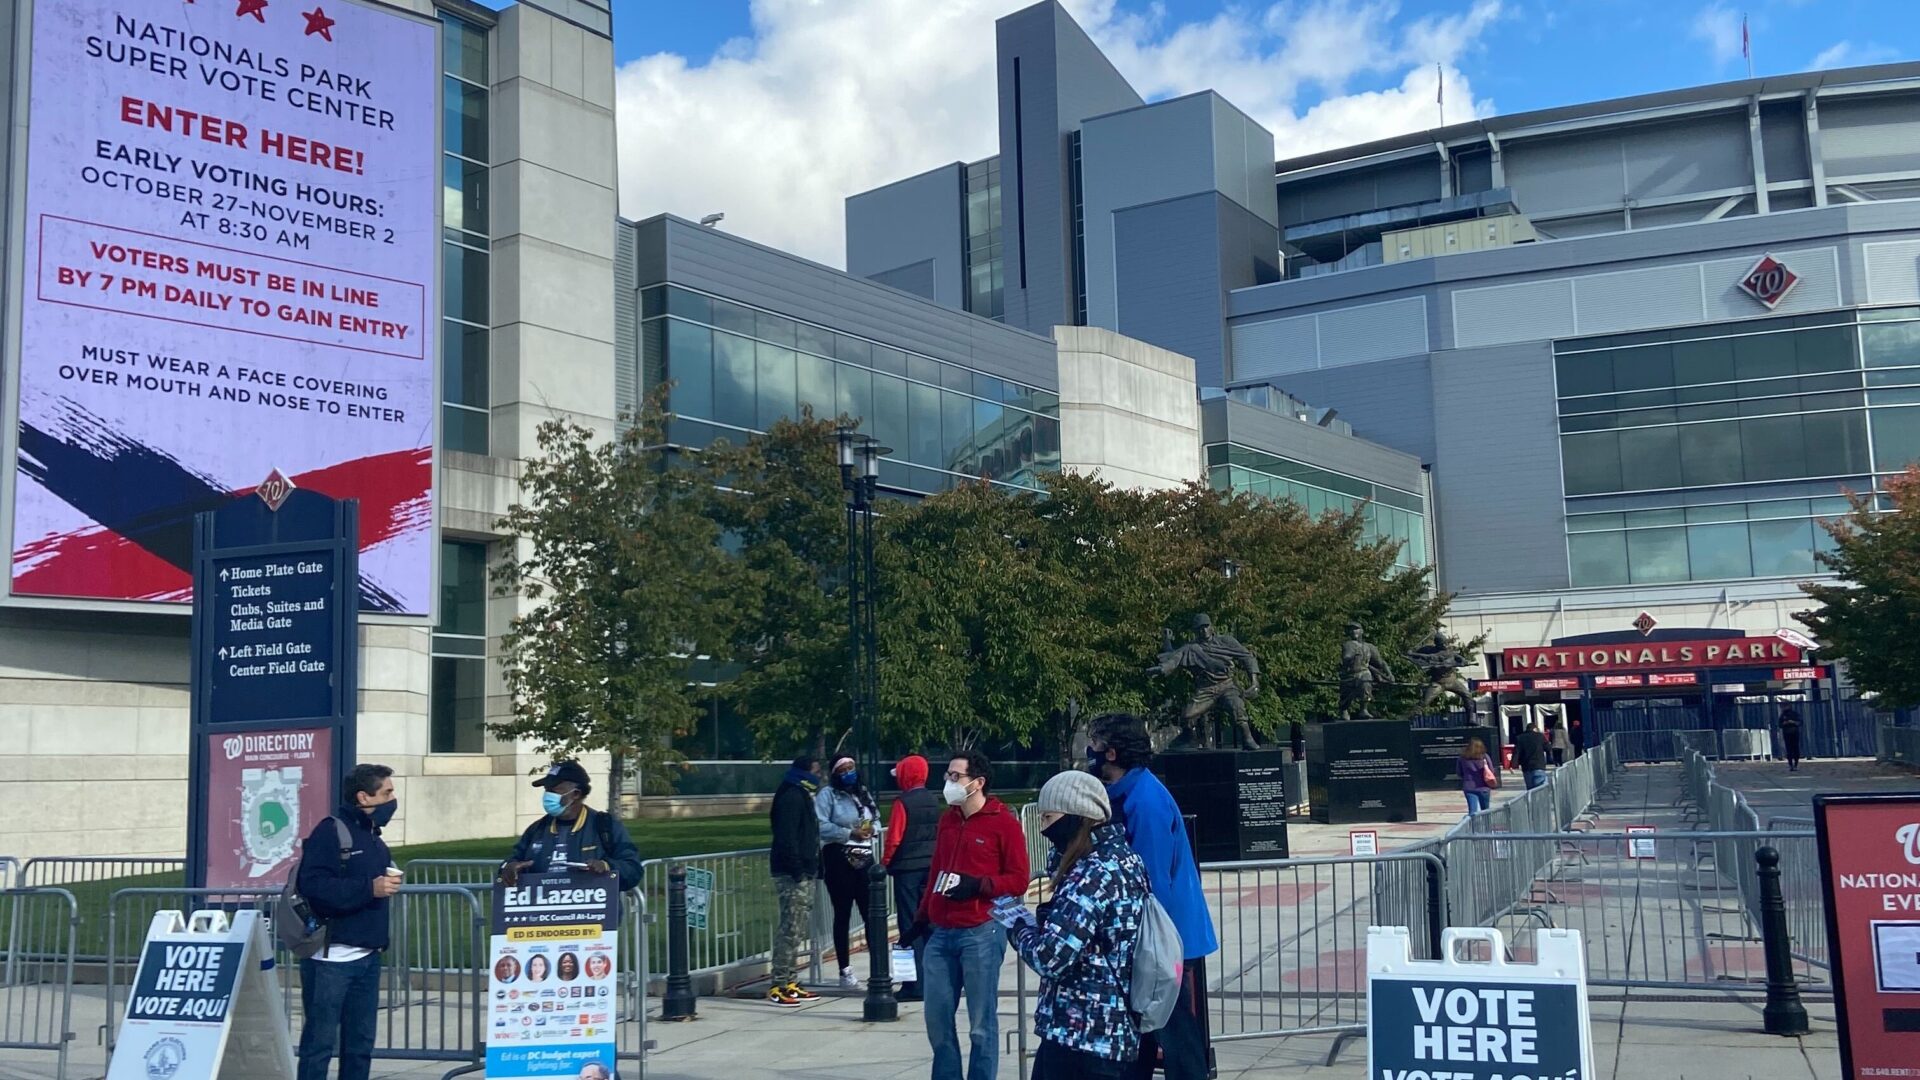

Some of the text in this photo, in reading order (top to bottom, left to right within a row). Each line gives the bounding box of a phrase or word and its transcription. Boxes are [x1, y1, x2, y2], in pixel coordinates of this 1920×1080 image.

[115, 15, 372, 100] NATIONALS PARK
[85, 36, 395, 131] SUPER VOTE CENTER
[120, 95, 365, 176] ENTER HERE!
[96, 139, 385, 218] EARLY VOTING HOURS:
[81, 166, 203, 206] OCTOBER
[382, 227, 395, 245] 2
[180, 210, 311, 250] AT 8:30 AM
[90, 241, 380, 308] VOTERS MUST BE IN LINE
[57, 266, 409, 340] BY 7 PM DAILY TO GAIN ENTRY
[81, 344, 389, 401] MUST WEAR A FACE COVERING
[58, 365, 406, 424] OVER MOUTH AND NOSE TO ENTER
[230, 561, 323, 580] Home Plate Gate
[230, 584, 271, 598] Tickets
[230, 597, 324, 617] Clubs, Suites and
[230, 616, 292, 632] Media Gate
[229, 642, 311, 659] Left Field Gate
[1511, 641, 1788, 670] NATIONALS PARK
[229, 659, 325, 677] Center Field Gate
[1783, 671, 1816, 680] ENTRANCE
[245, 733, 315, 753] DIRECTORY
[294, 752, 310, 760] FLOOR
[1840, 873, 1920, 889] NATION
[504, 885, 607, 906] Ed Lazere
[529, 912, 606, 922] for DC Council At-Large
[514, 931, 525, 939] ED
[536, 929, 581, 938] ENDORSED
[583, 928, 596, 936] BY:
[165, 945, 224, 970] VOTE
[155, 969, 219, 992] HERE
[135, 994, 229, 1018] VOTE AQUÍ
[1411, 987, 1536, 1027] VOTE
[501, 1052, 511, 1061] Ed
[512, 1053, 519, 1061] is
[527, 1051, 540, 1060] DC
[541, 1050, 571, 1062] budget
[572, 1049, 600, 1061] expert
[1413, 1025, 1539, 1064] HERE
[527, 1061, 558, 1073] fighting
